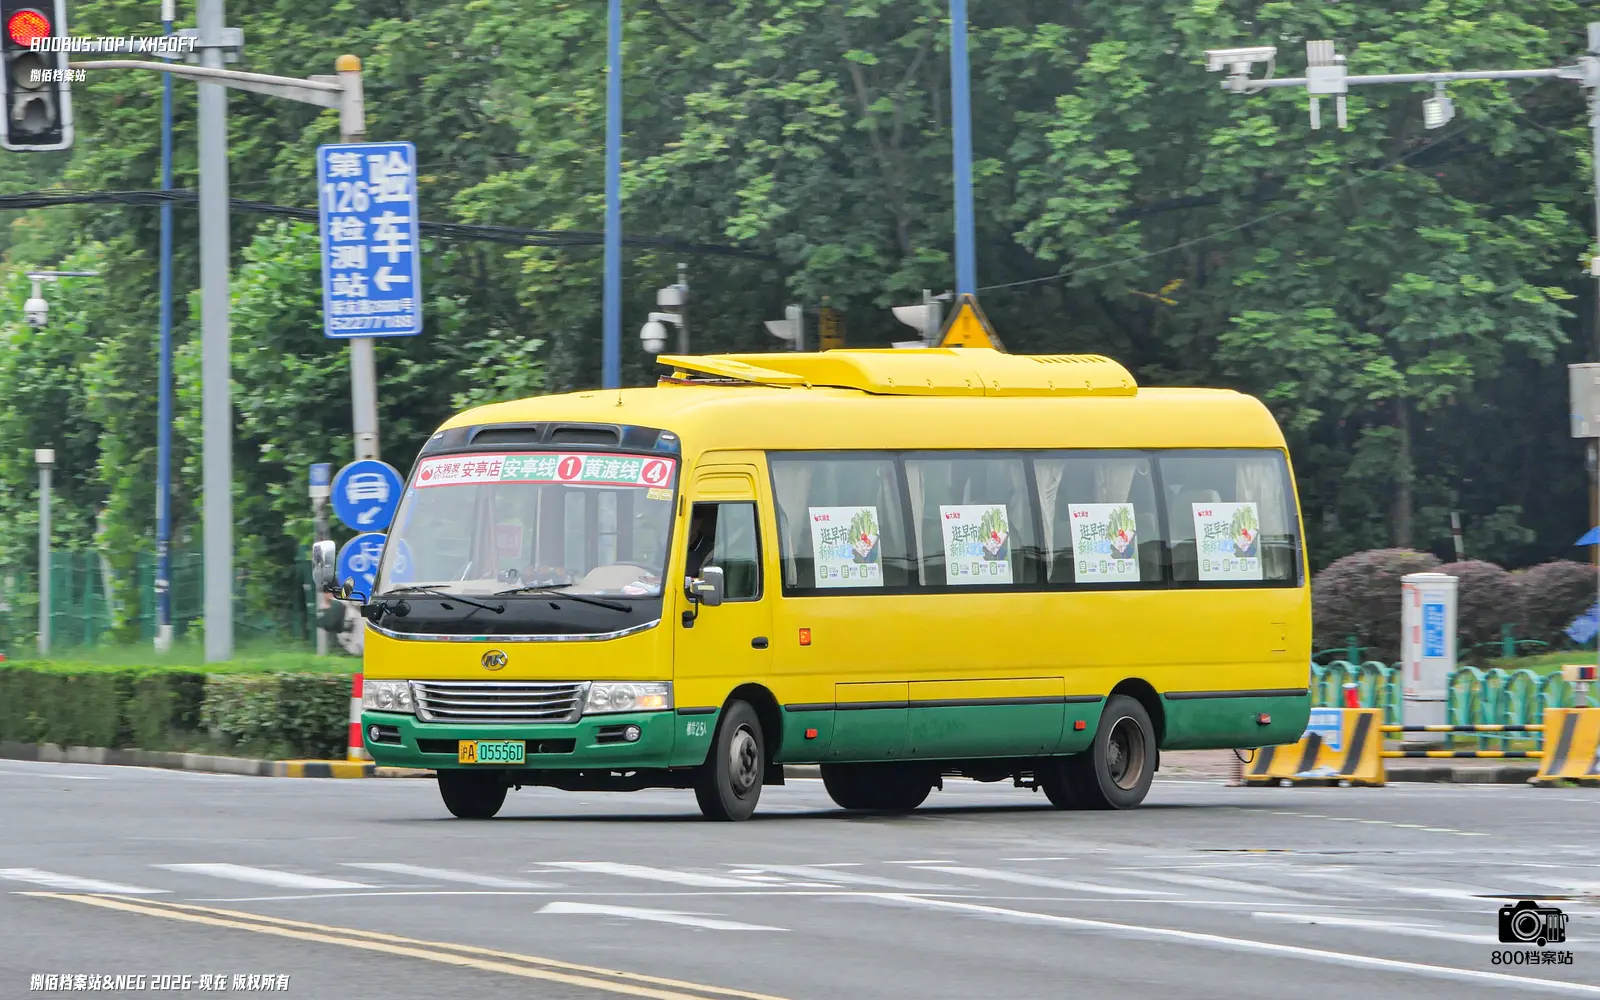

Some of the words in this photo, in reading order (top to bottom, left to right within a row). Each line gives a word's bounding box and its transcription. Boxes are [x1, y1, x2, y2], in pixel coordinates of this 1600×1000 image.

[366, 151, 412, 263] 验车
[461, 460, 503, 477] 安亭店
[503, 458, 556, 478] 安亭线
[584, 458, 640, 480] 黄渡线
[820, 525, 847, 544] 逛早市
[951, 523, 978, 542] 逛早市
[460, 744, 475, 760] 沪A
